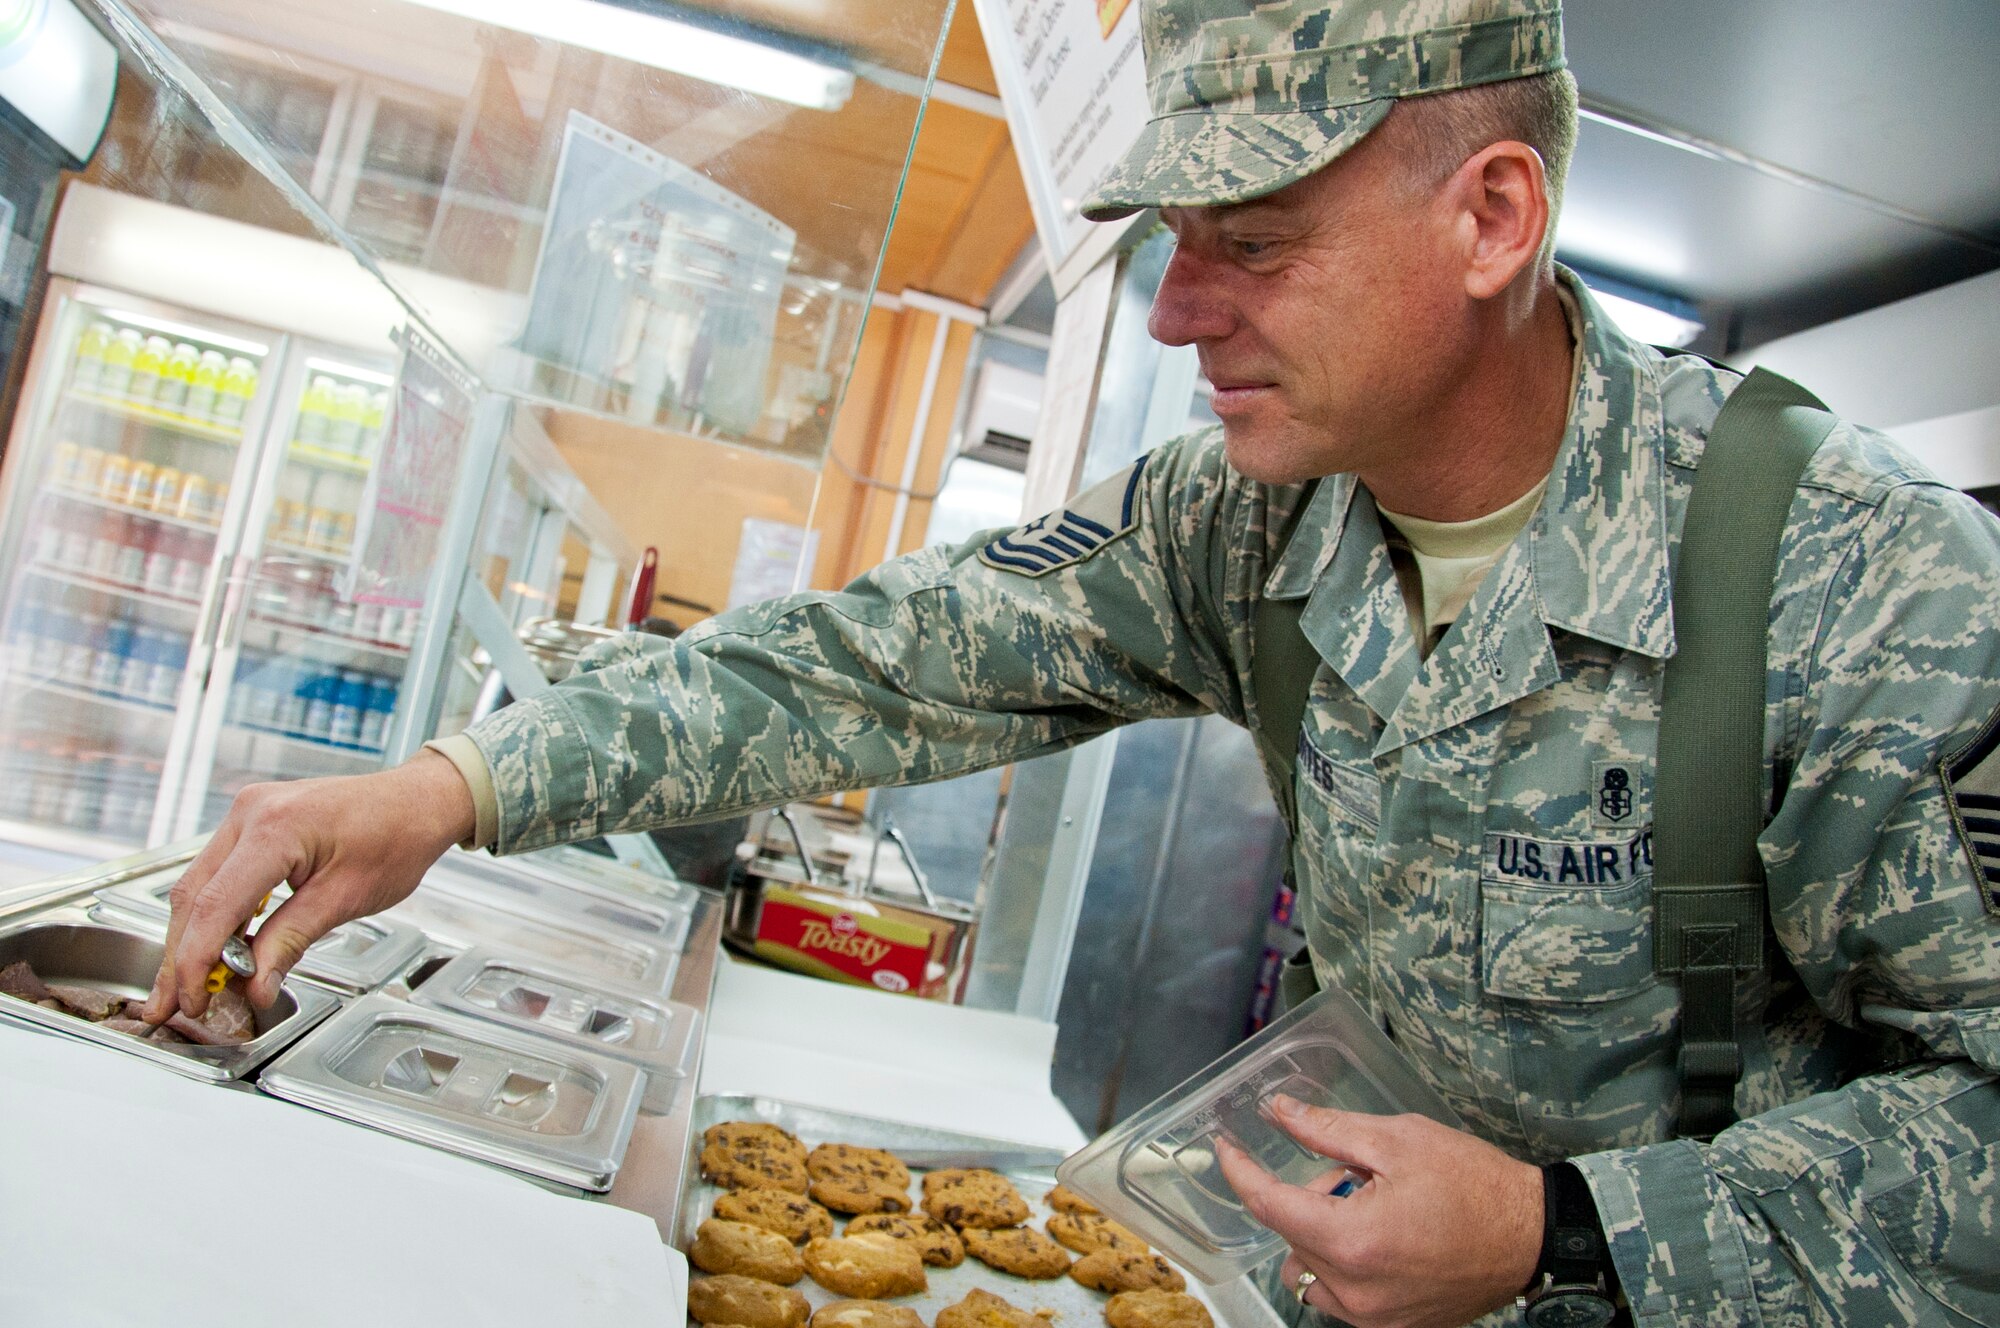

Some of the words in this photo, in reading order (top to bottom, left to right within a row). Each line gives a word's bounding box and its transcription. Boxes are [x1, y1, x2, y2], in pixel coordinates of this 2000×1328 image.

[1498, 838, 1550, 882] U.S.
[1558, 845, 1622, 883] AIR
[799, 918, 892, 967] Toasty
